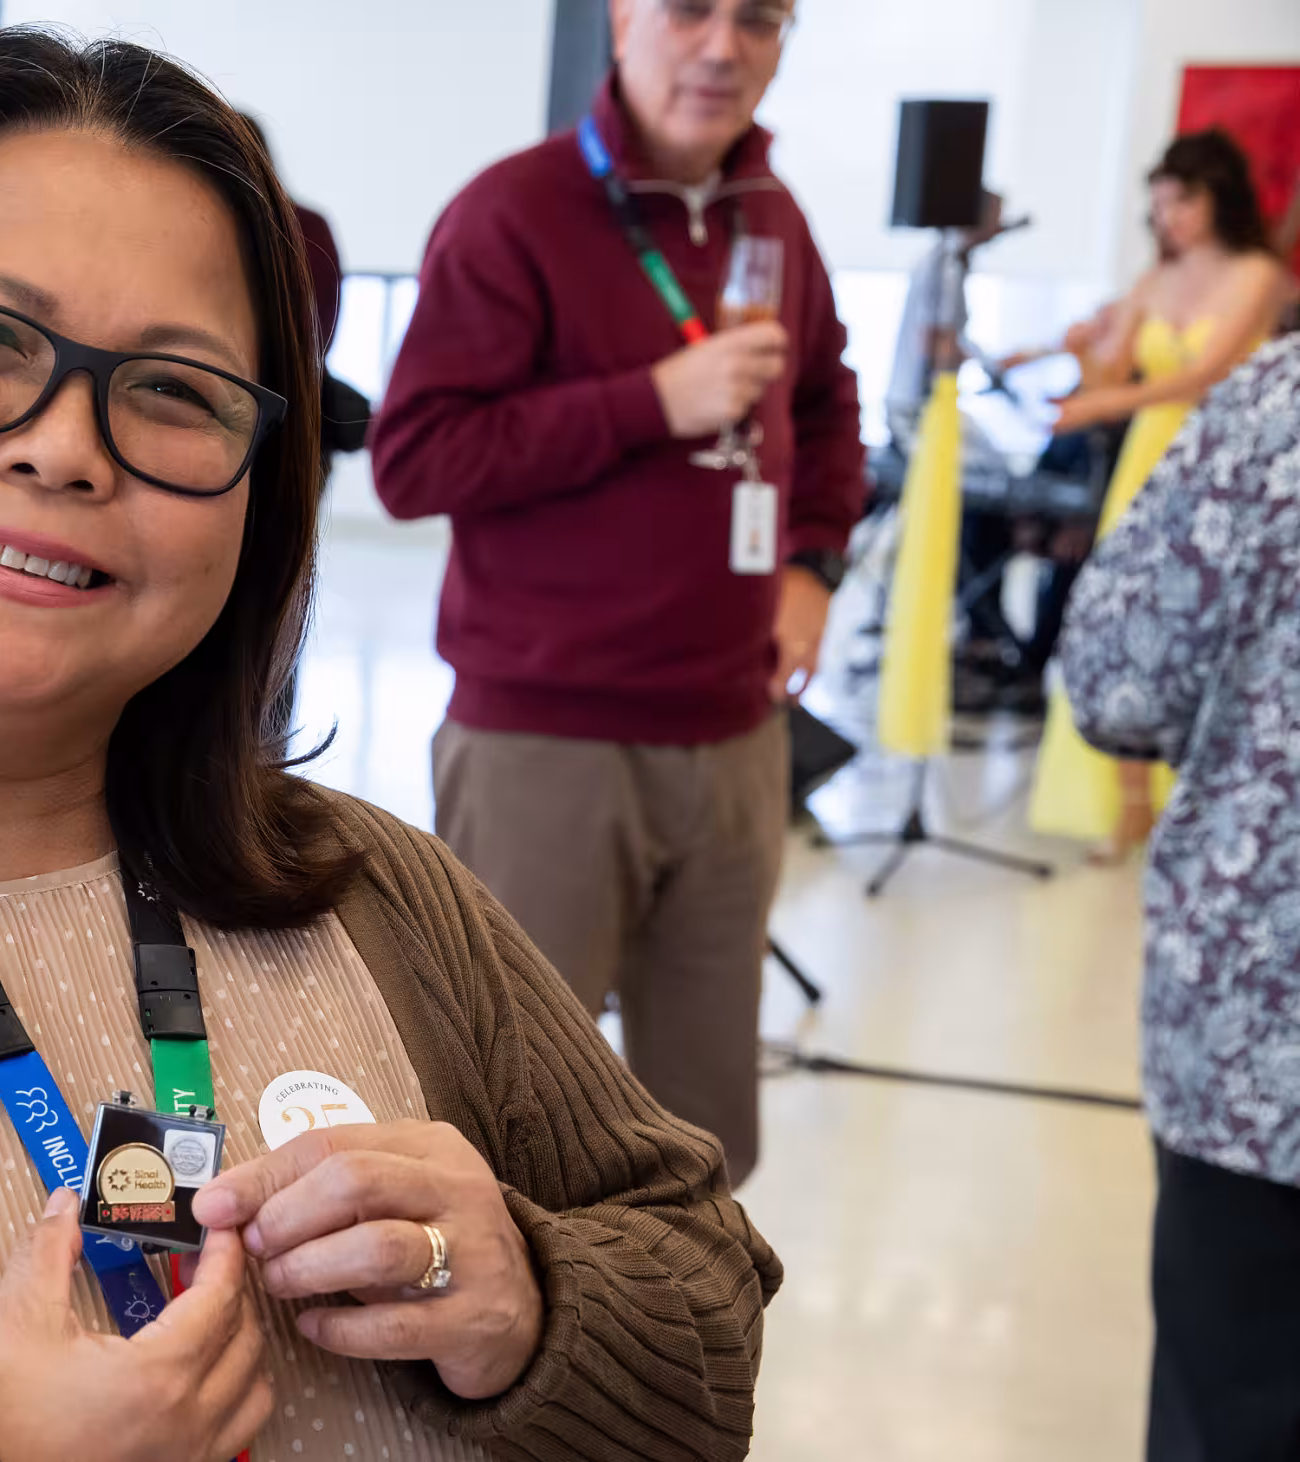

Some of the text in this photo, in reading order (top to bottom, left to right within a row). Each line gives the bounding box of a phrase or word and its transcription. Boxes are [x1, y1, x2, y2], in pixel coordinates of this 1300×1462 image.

[275, 1081, 339, 1102] CELEBRATING
[134, 1168, 159, 1179] Sinai
[134, 1179, 166, 1190] Health
